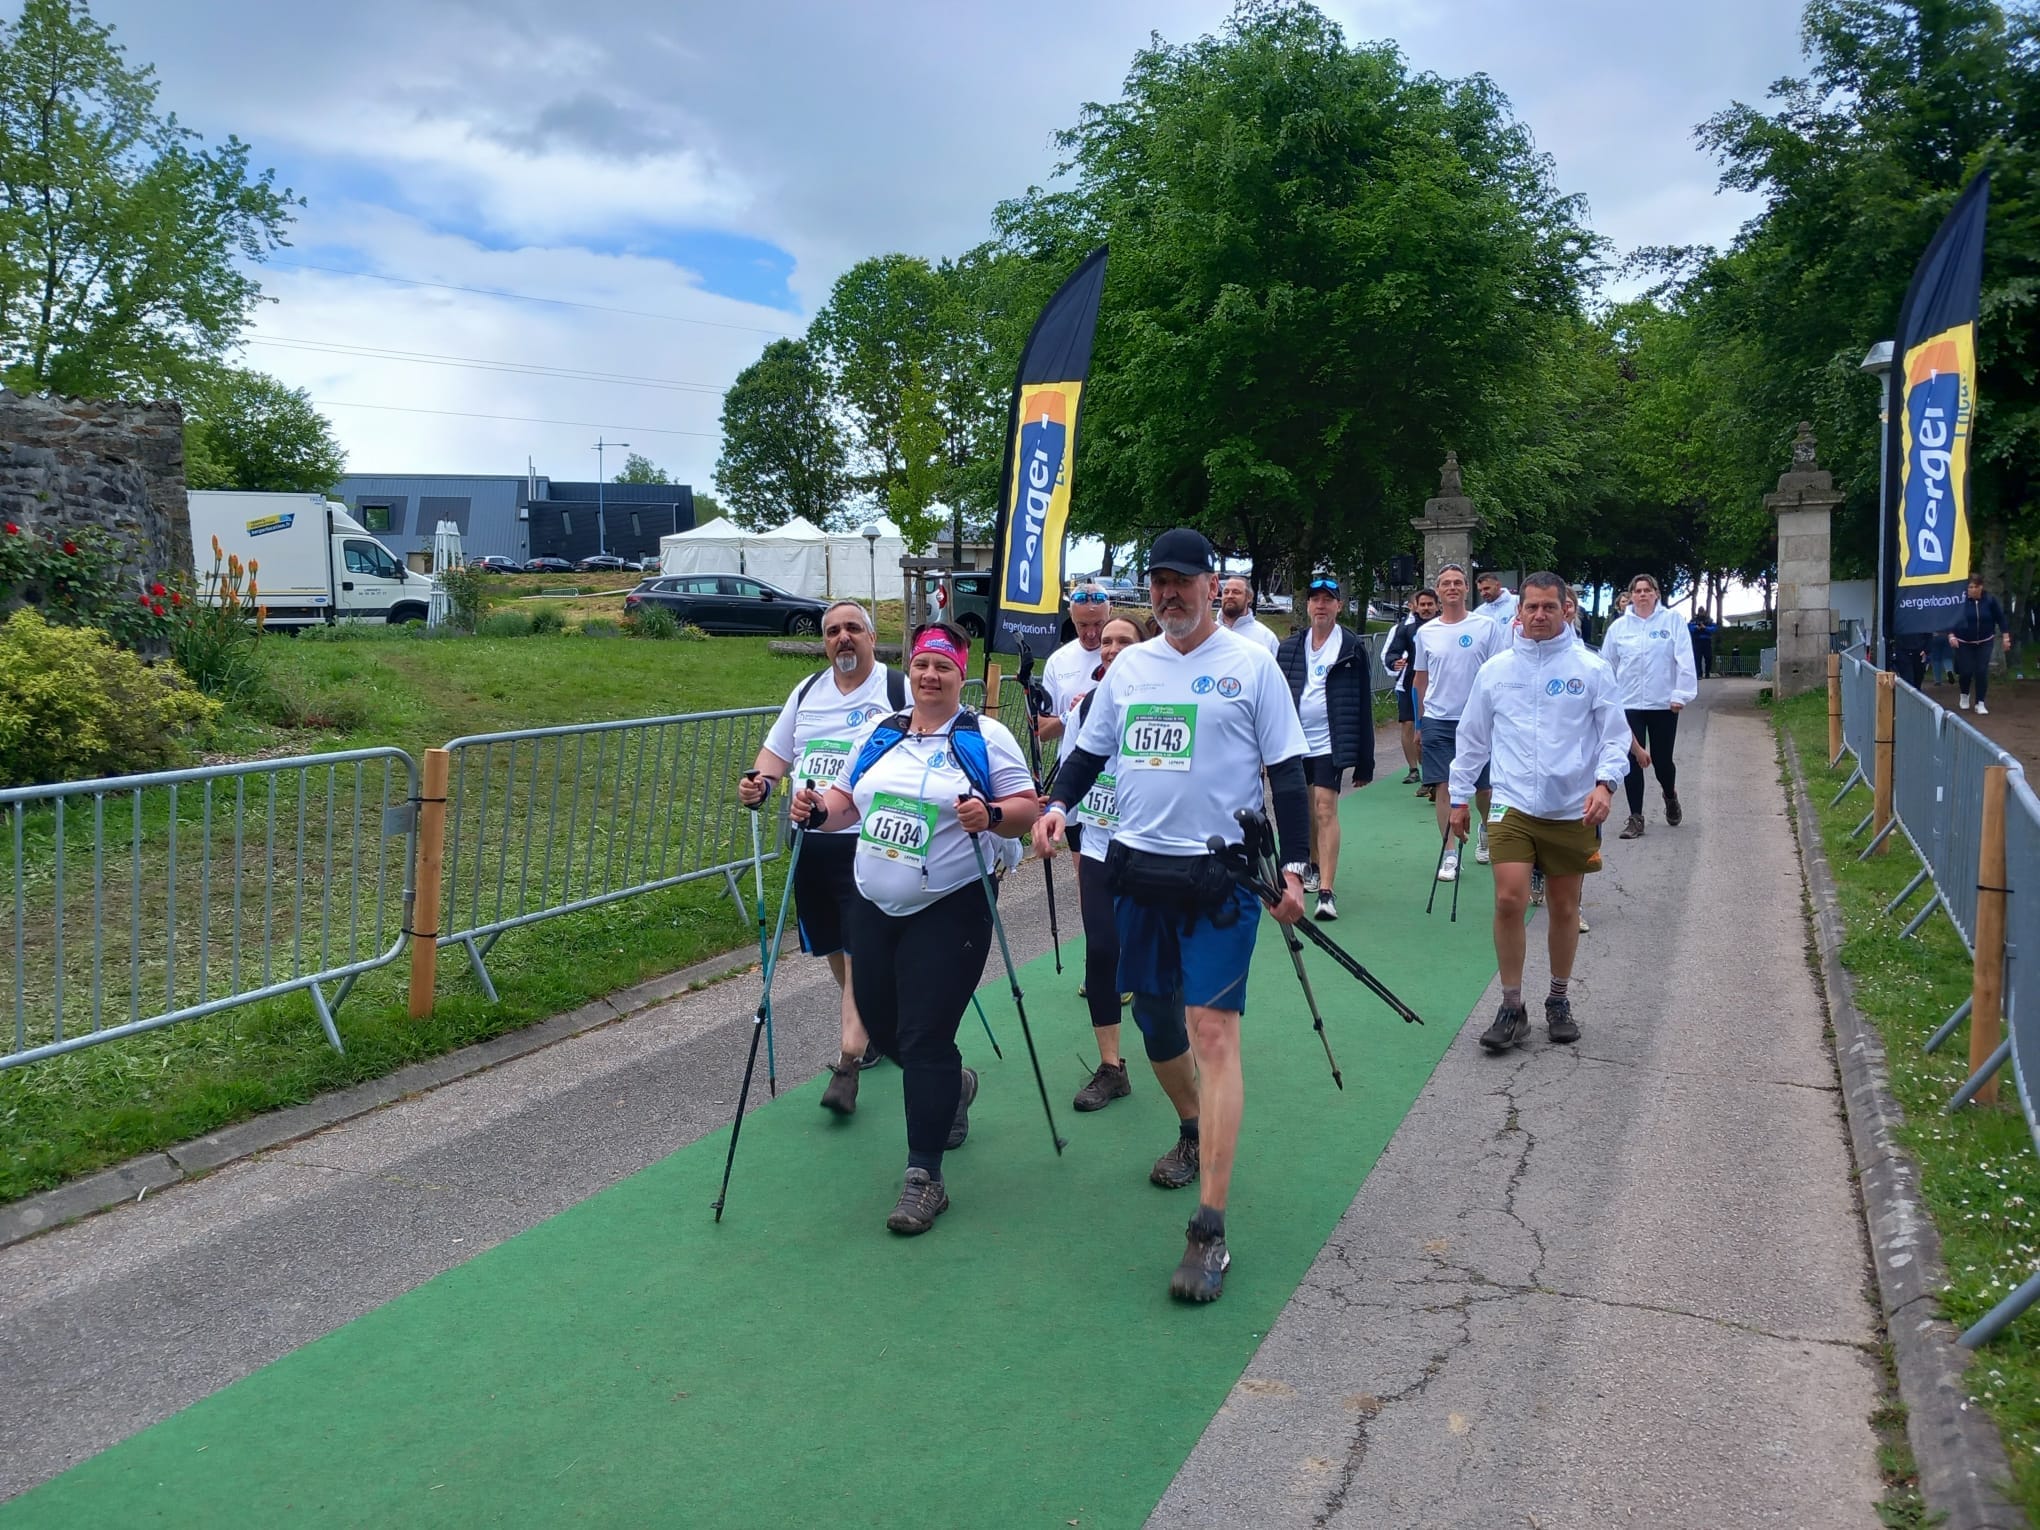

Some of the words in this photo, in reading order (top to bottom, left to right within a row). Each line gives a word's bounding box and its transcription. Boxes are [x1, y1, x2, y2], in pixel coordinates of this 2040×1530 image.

[1135, 727, 1183, 752] 15143
[1088, 791, 1120, 817] 1513
[873, 816, 921, 848] 15134
